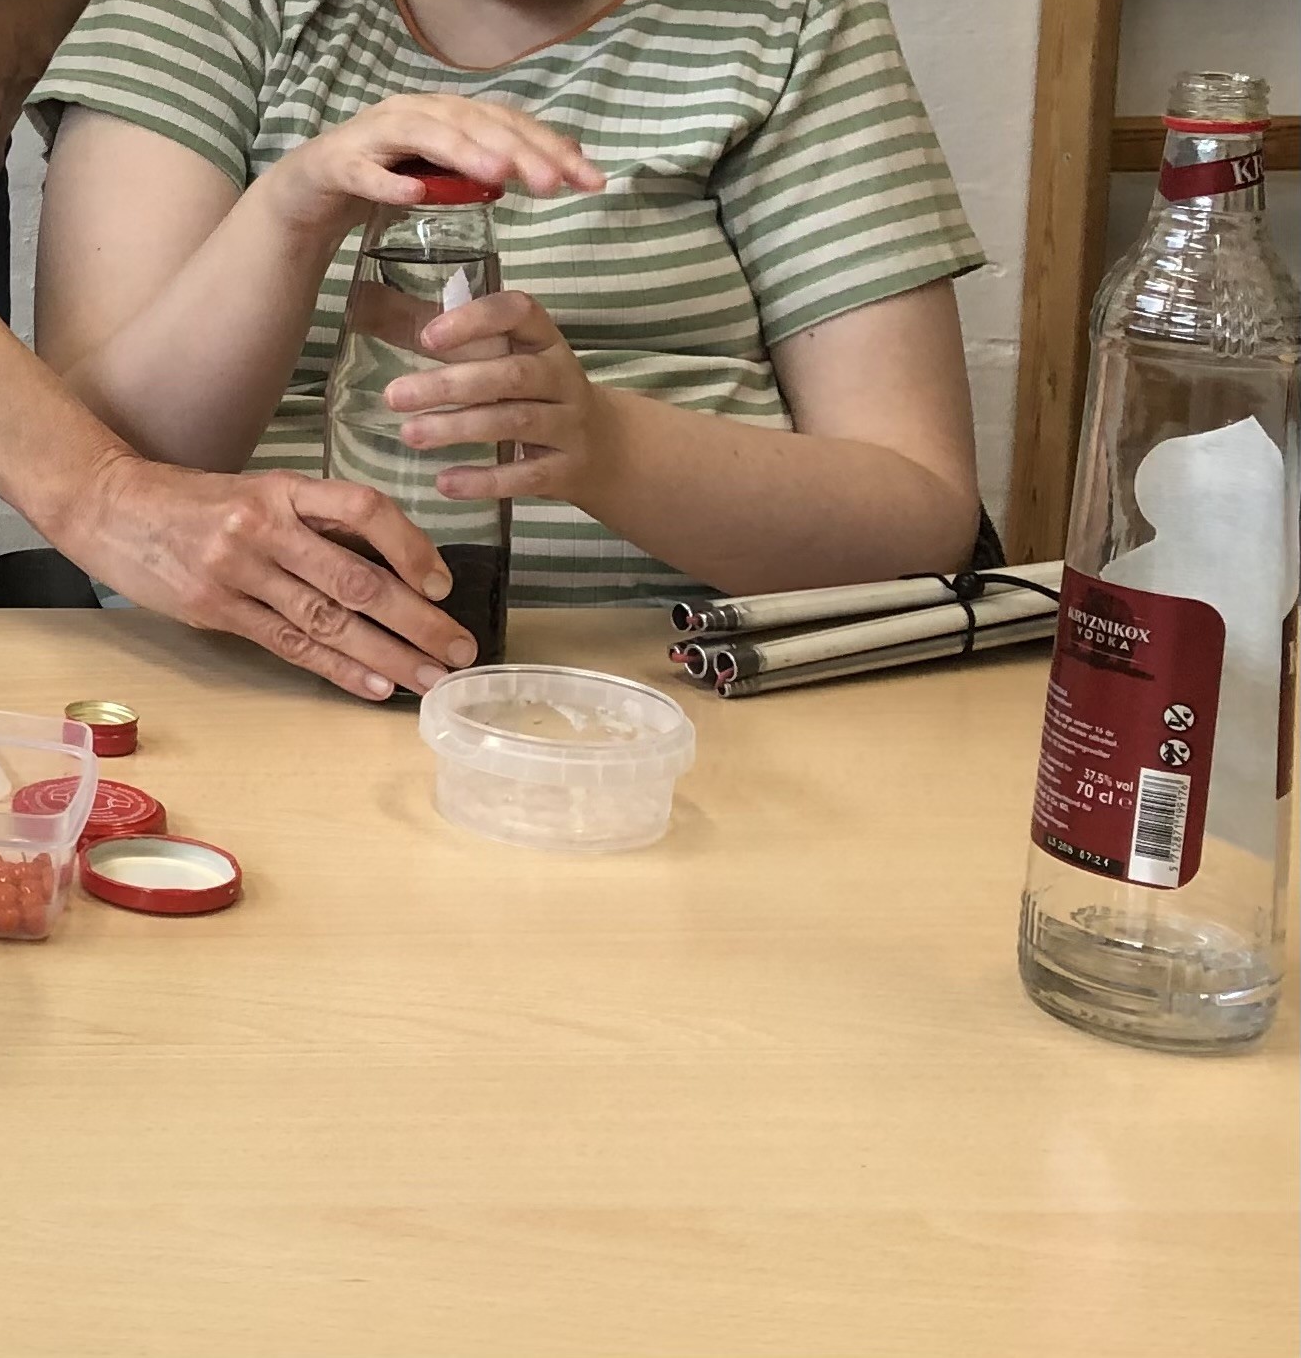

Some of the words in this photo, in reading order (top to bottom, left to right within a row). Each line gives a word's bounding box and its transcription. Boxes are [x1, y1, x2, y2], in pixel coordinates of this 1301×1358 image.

[1077, 626, 1130, 651] VODKA
[1077, 780, 1094, 798] 70
[1099, 791, 1113, 805] cl
[1116, 781, 1134, 792] vol
